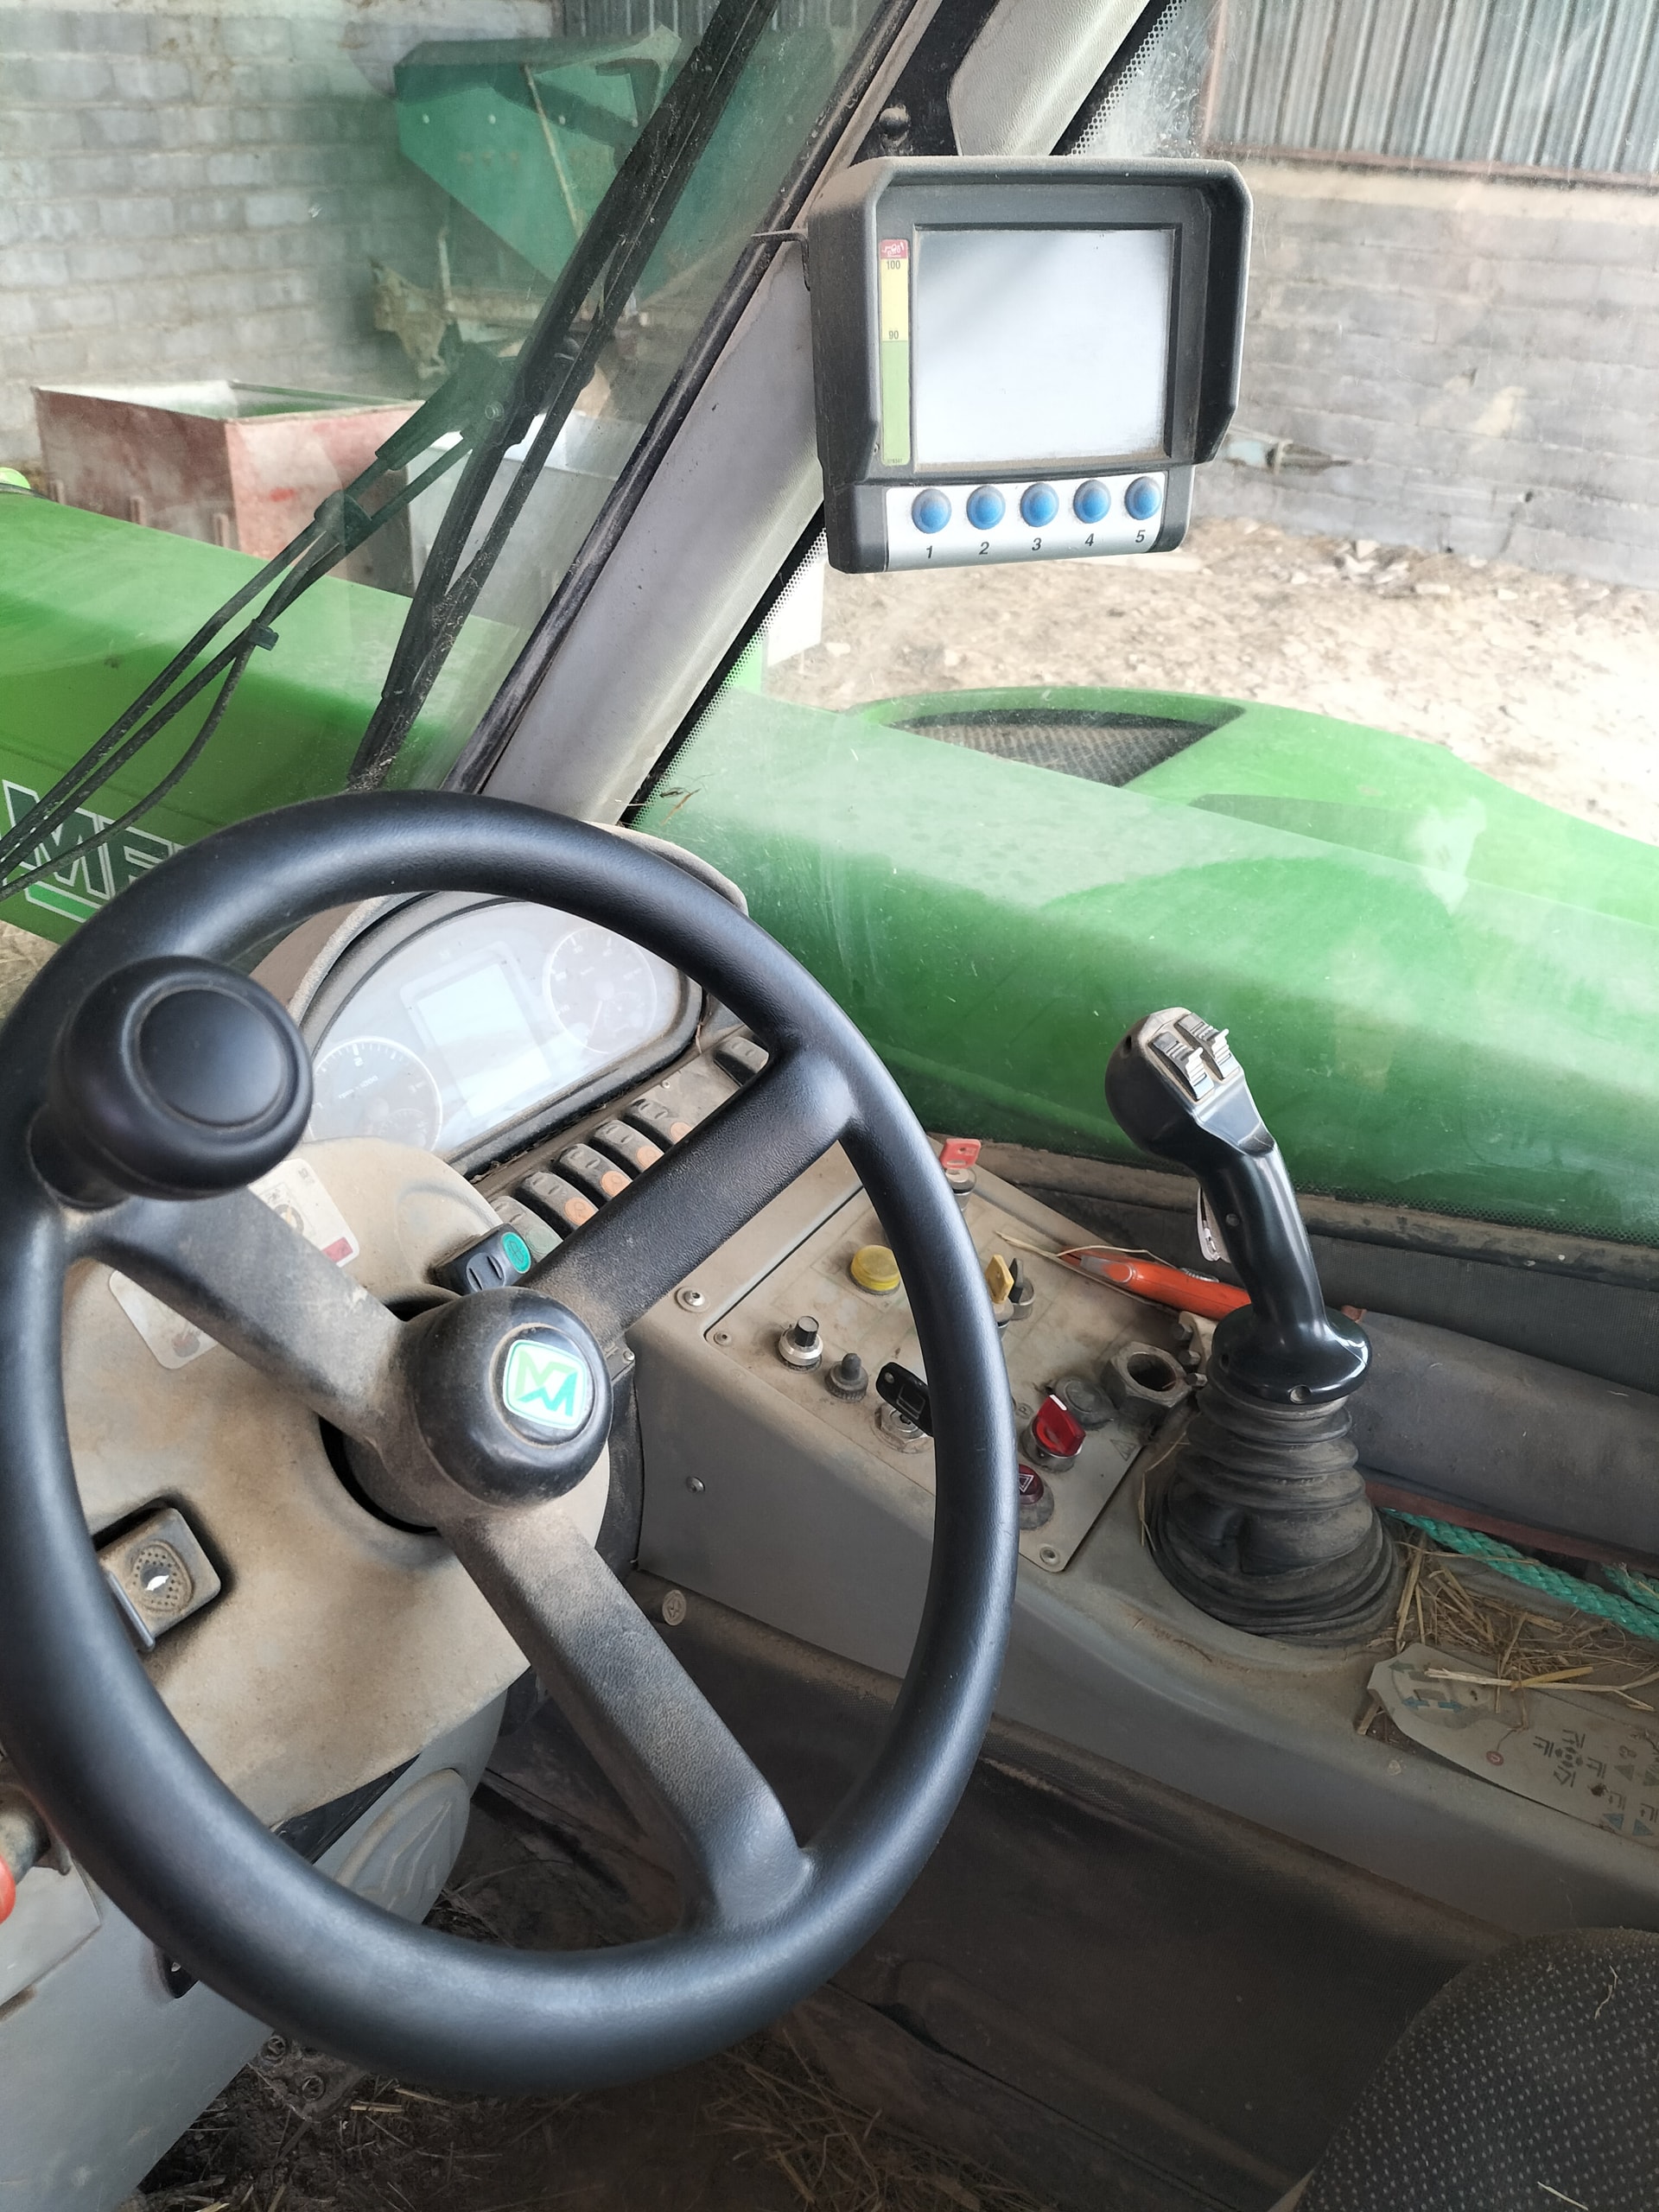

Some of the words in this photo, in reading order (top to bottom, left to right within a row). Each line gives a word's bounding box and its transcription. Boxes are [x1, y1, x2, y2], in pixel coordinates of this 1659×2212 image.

[886, 259, 901, 270] 100
[888, 330, 899, 340] 90
[926, 544, 934, 558] 1
[979, 542, 990, 556] 2
[1031, 537, 1042, 550] 3
[1084, 533, 1095, 546] 4
[1135, 530, 1146, 543] 5
